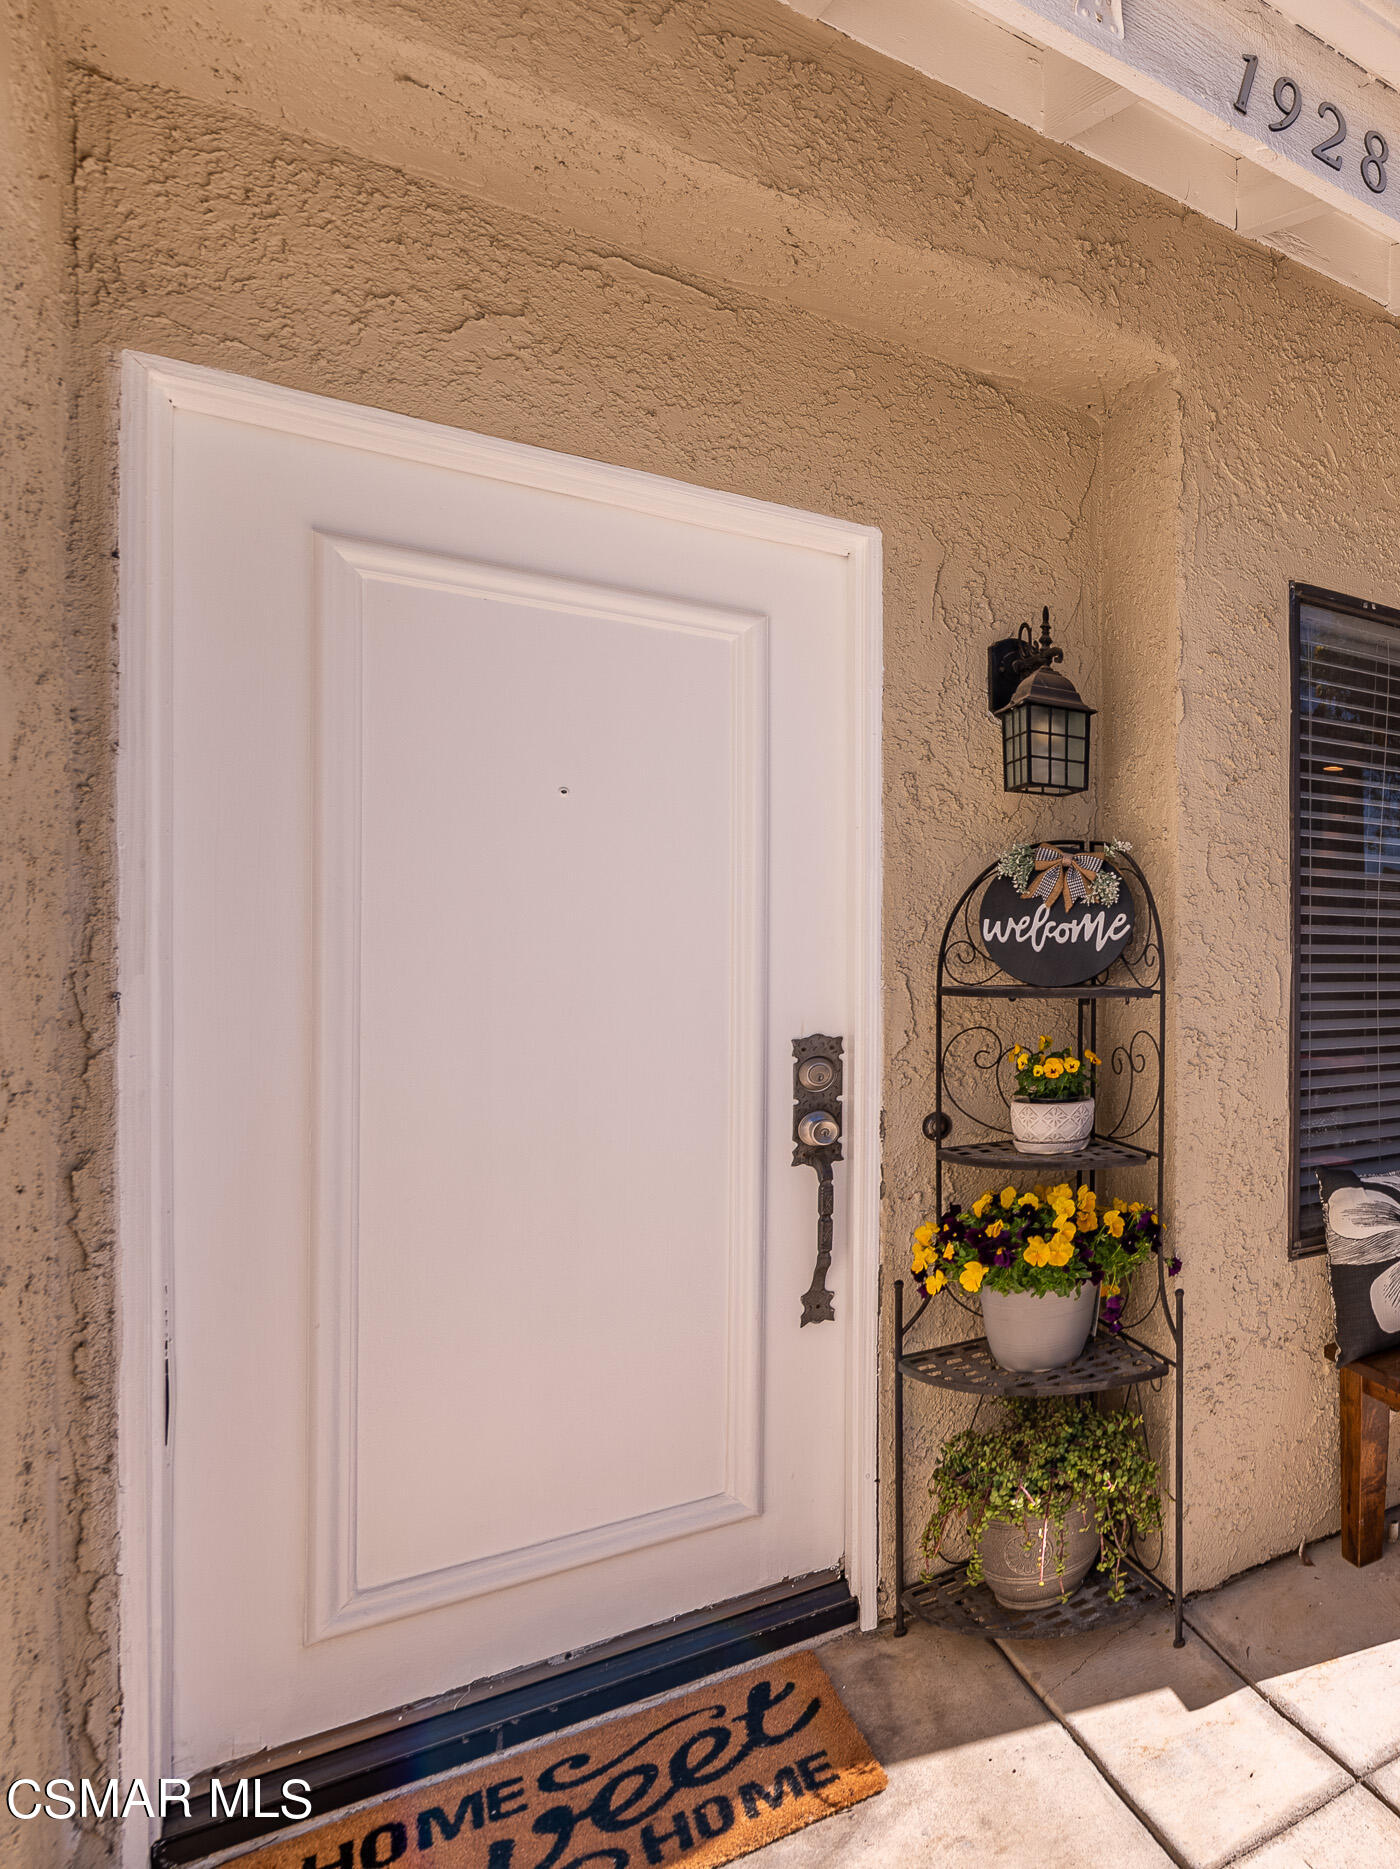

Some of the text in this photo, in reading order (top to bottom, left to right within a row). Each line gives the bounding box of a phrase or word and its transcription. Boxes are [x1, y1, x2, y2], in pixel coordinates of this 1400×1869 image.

[1233, 53, 1390, 194] 1928
[982, 903, 1131, 952] welcome
[640, 1749, 841, 1865] HOME
